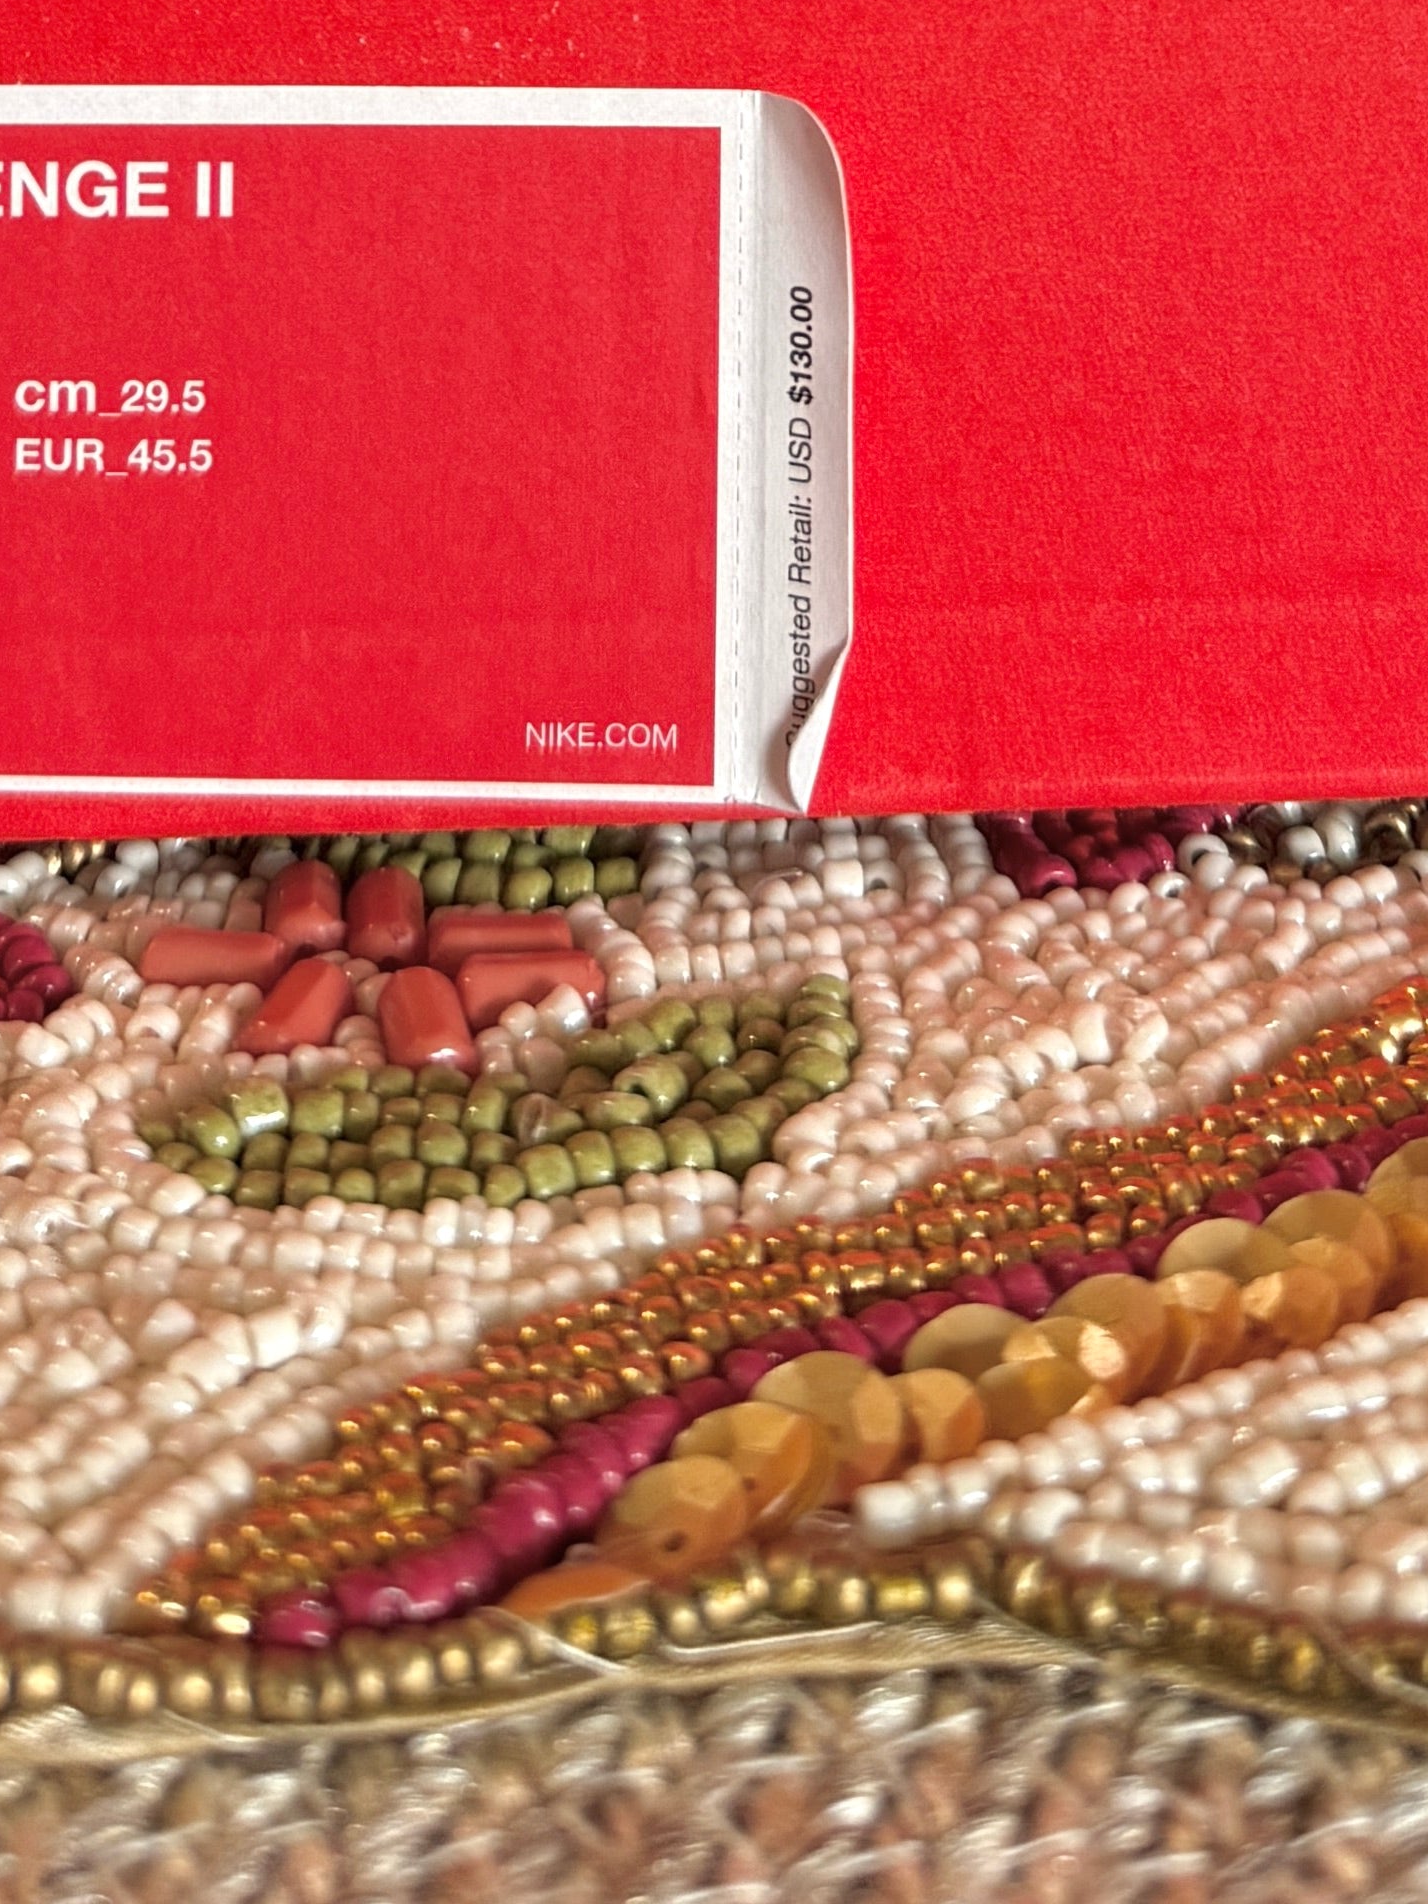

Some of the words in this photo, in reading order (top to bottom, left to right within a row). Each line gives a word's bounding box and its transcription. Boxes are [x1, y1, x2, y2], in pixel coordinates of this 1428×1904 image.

[197, 162, 233, 217] II
[786, 286, 814, 405] $130.00
[15, 380, 205, 416] cm_29.5
[16, 438, 212, 476] EUR_45.5
[788, 417, 812, 484] USD
[788, 494, 812, 584] Retail:
[527, 723, 676, 749] NIKE.COM
